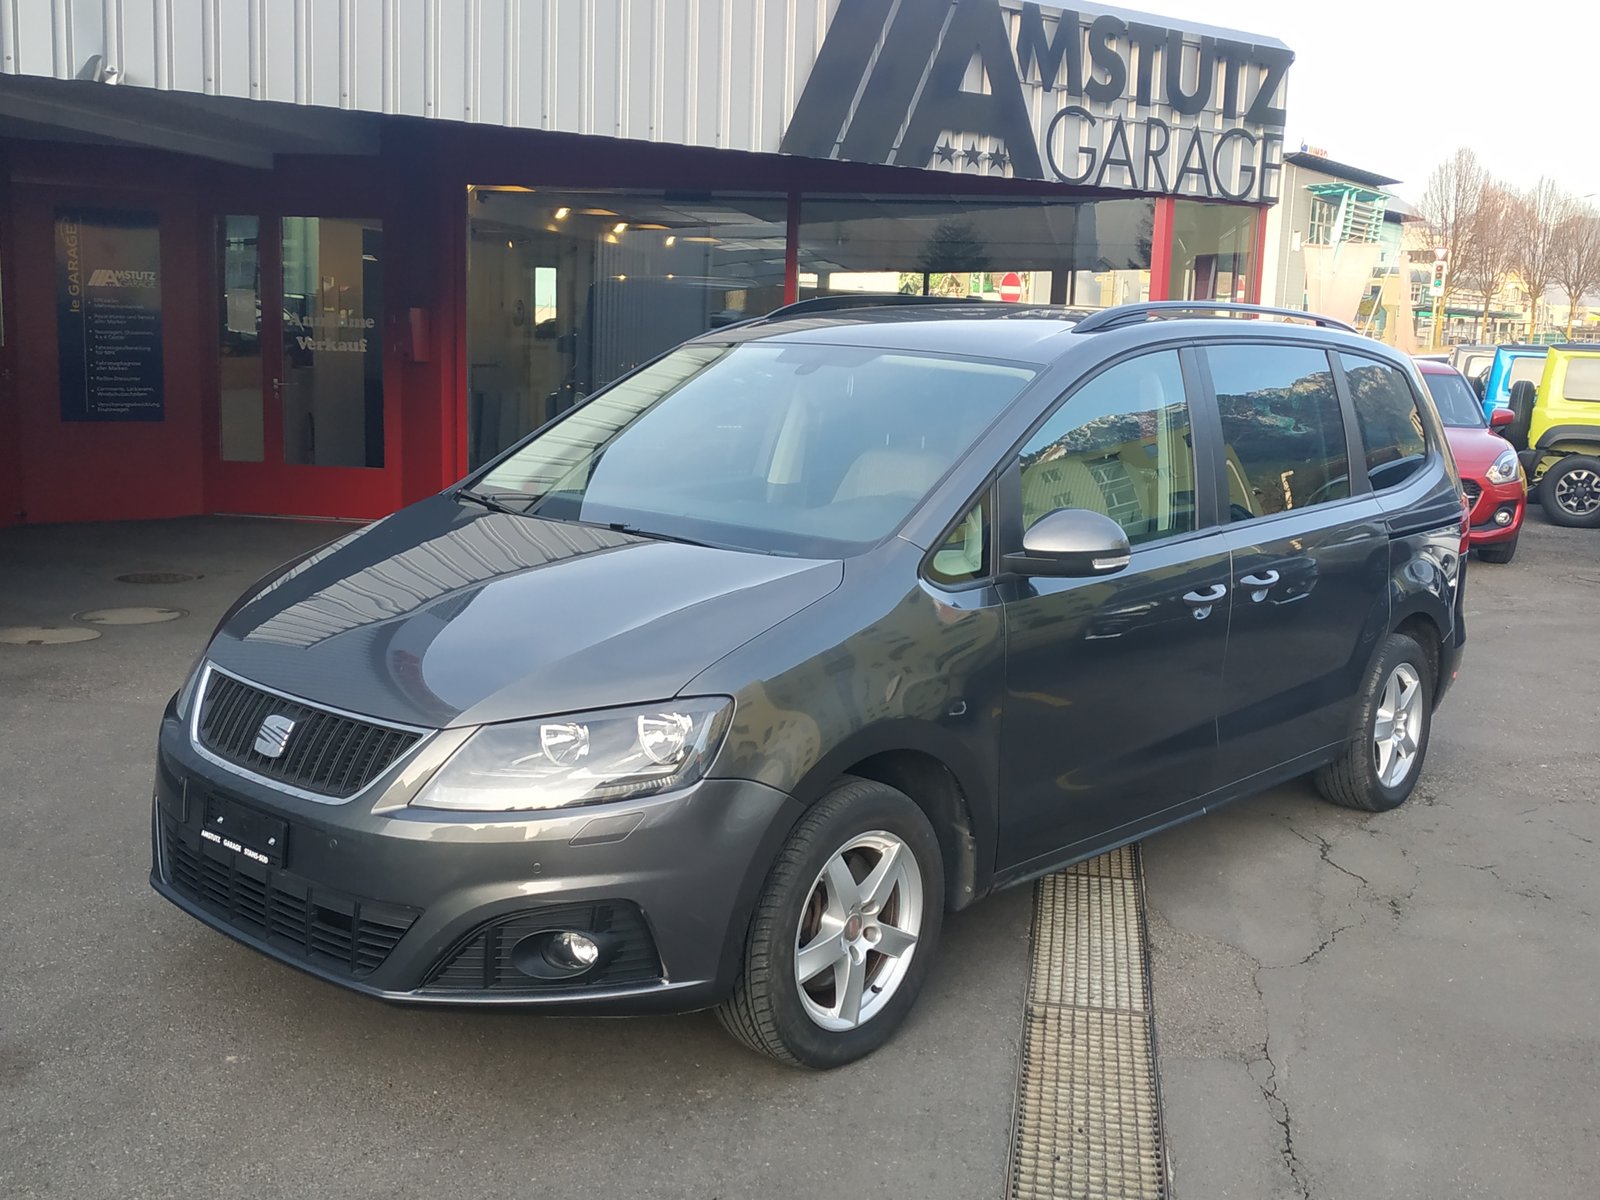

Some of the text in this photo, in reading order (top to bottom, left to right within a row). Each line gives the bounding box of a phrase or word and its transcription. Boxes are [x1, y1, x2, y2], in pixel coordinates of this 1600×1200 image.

[886, 0, 1295, 181] AMSTUTZ
[1045, 105, 1282, 204] GARAGE
[66, 224, 80, 312] le GARAGE
[102, 269, 156, 287] AMSTUTZ
[287, 312, 375, 328] Annme
[296, 335, 367, 352] Verkauf
